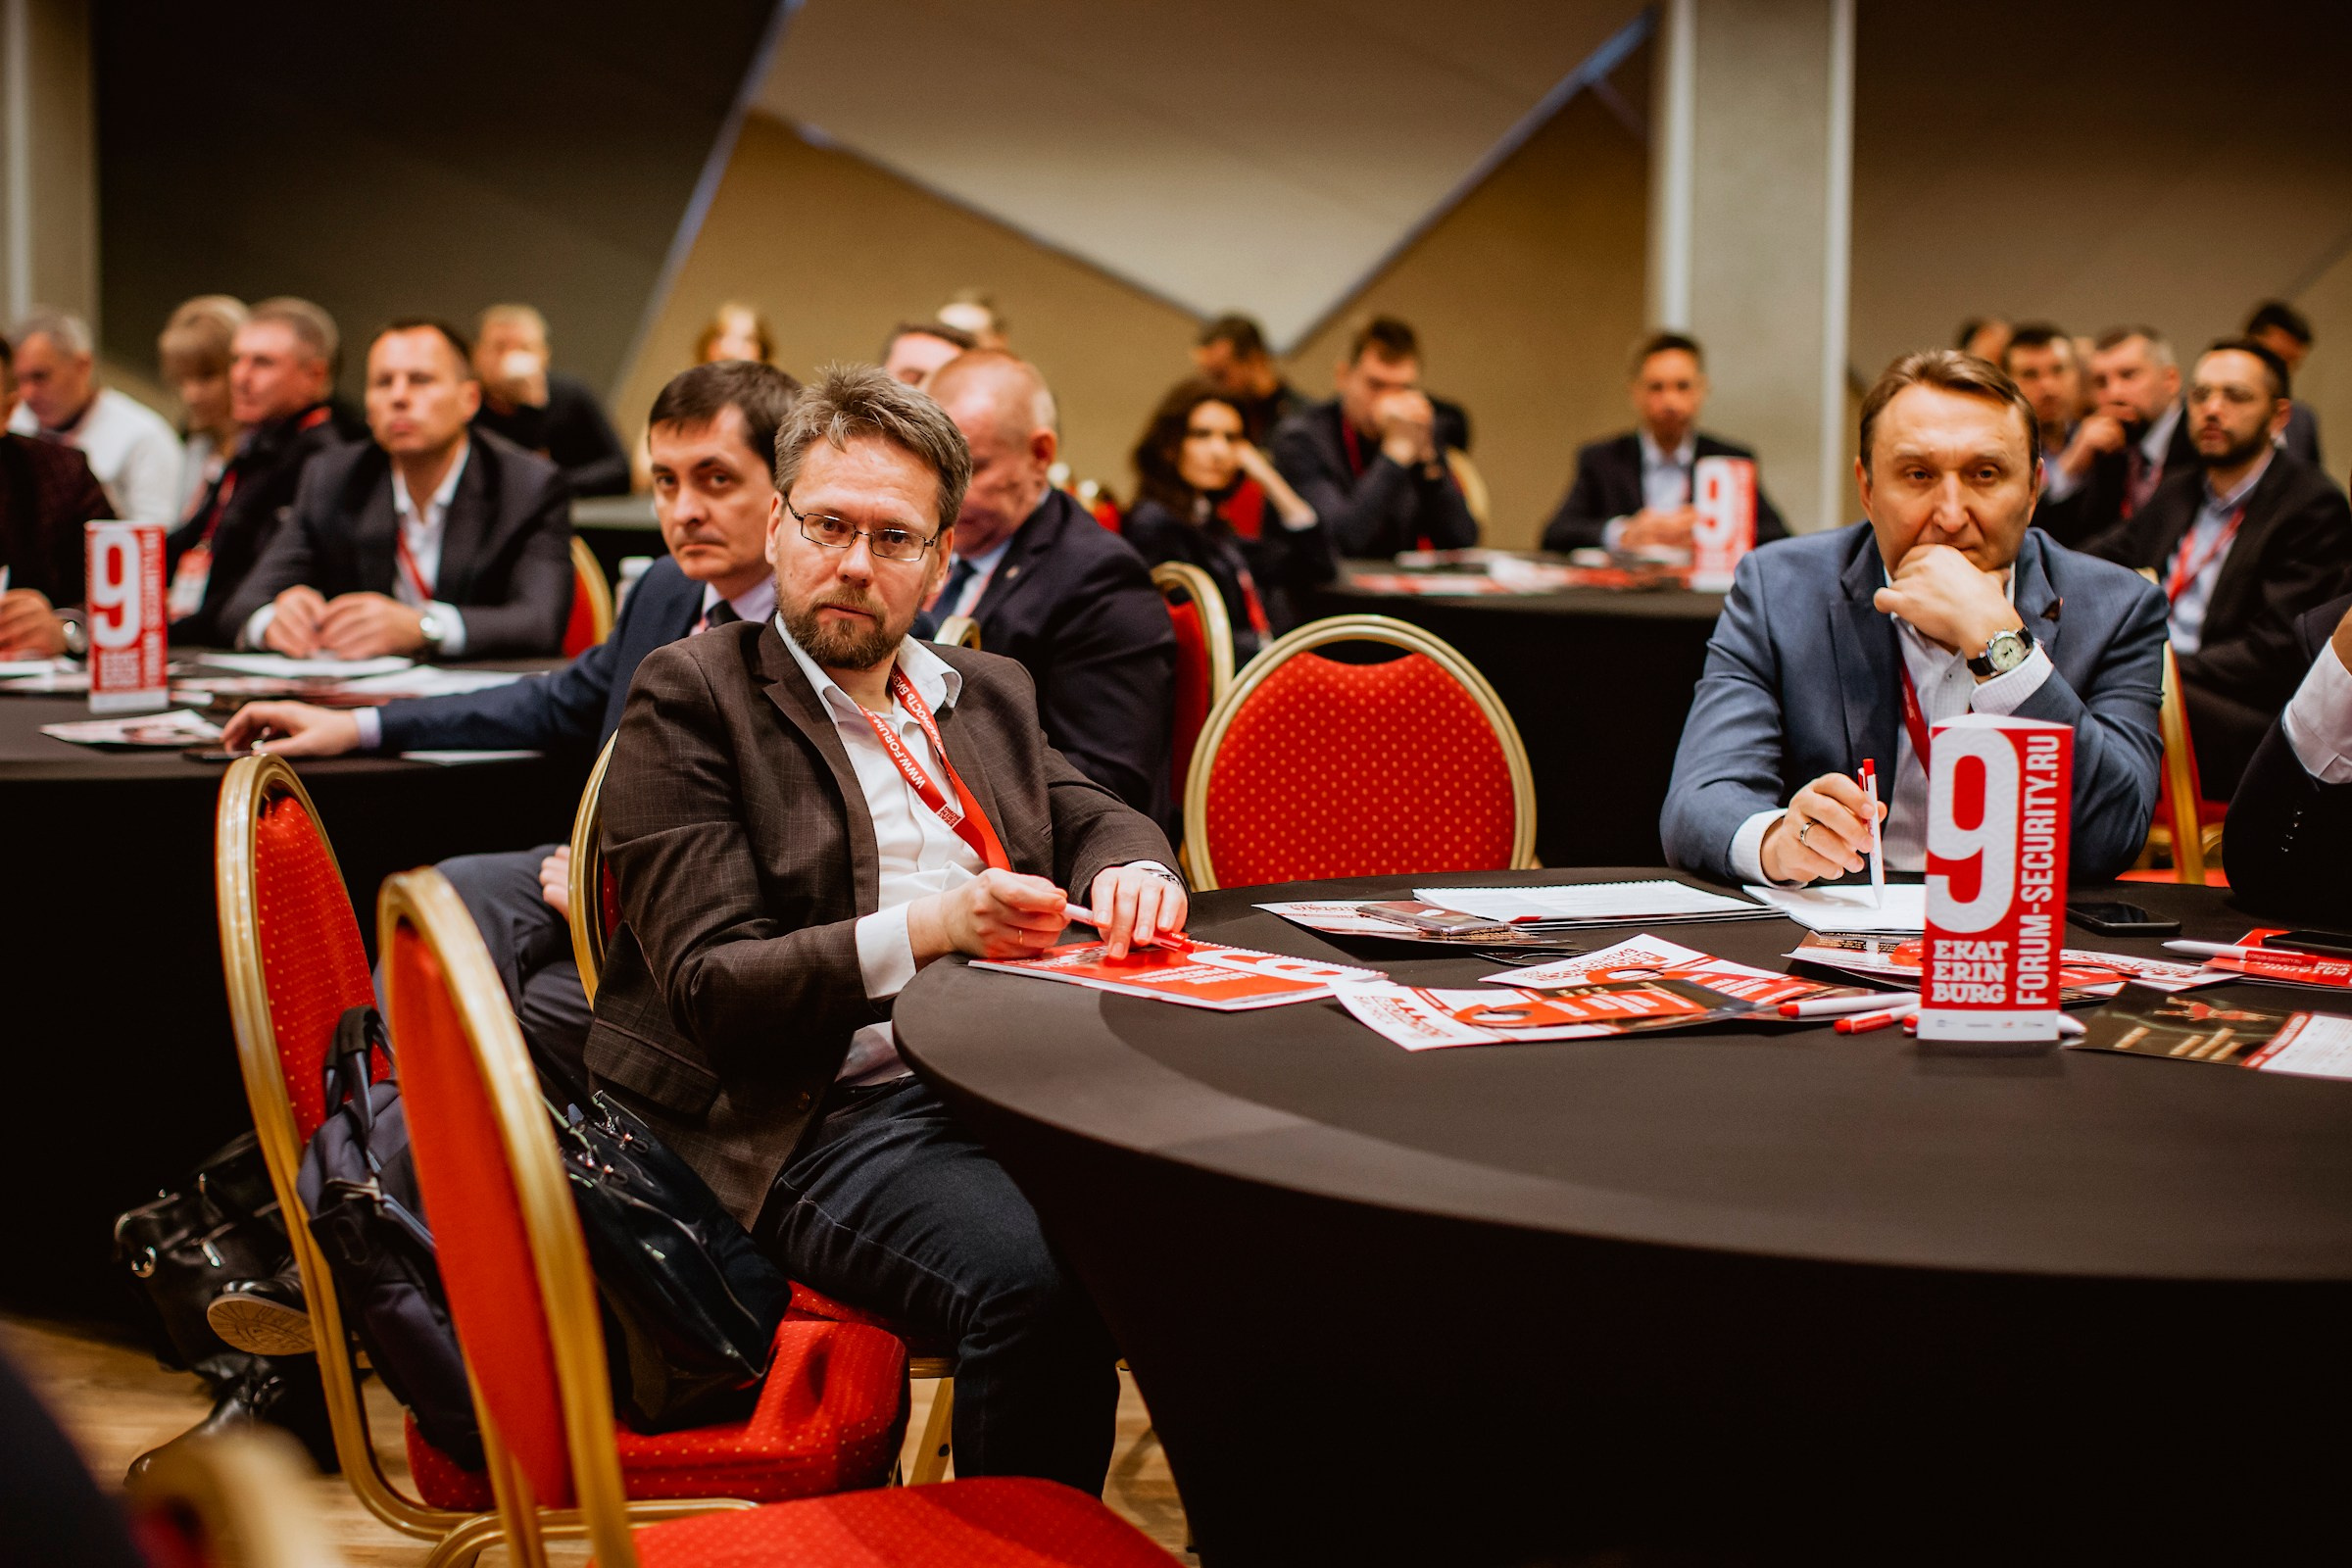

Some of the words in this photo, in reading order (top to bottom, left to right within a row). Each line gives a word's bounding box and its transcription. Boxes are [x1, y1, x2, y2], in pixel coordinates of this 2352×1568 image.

[1694, 459, 1734, 546] 9
[93, 530, 140, 648] 9
[1926, 728, 2020, 933] 9
[2016, 735, 2060, 1005] FORUM-SECURITY.RU
[1933, 961, 2007, 982] ERIN
[1934, 939, 2009, 960] EKAT
[1932, 983, 2006, 1004] BURG
